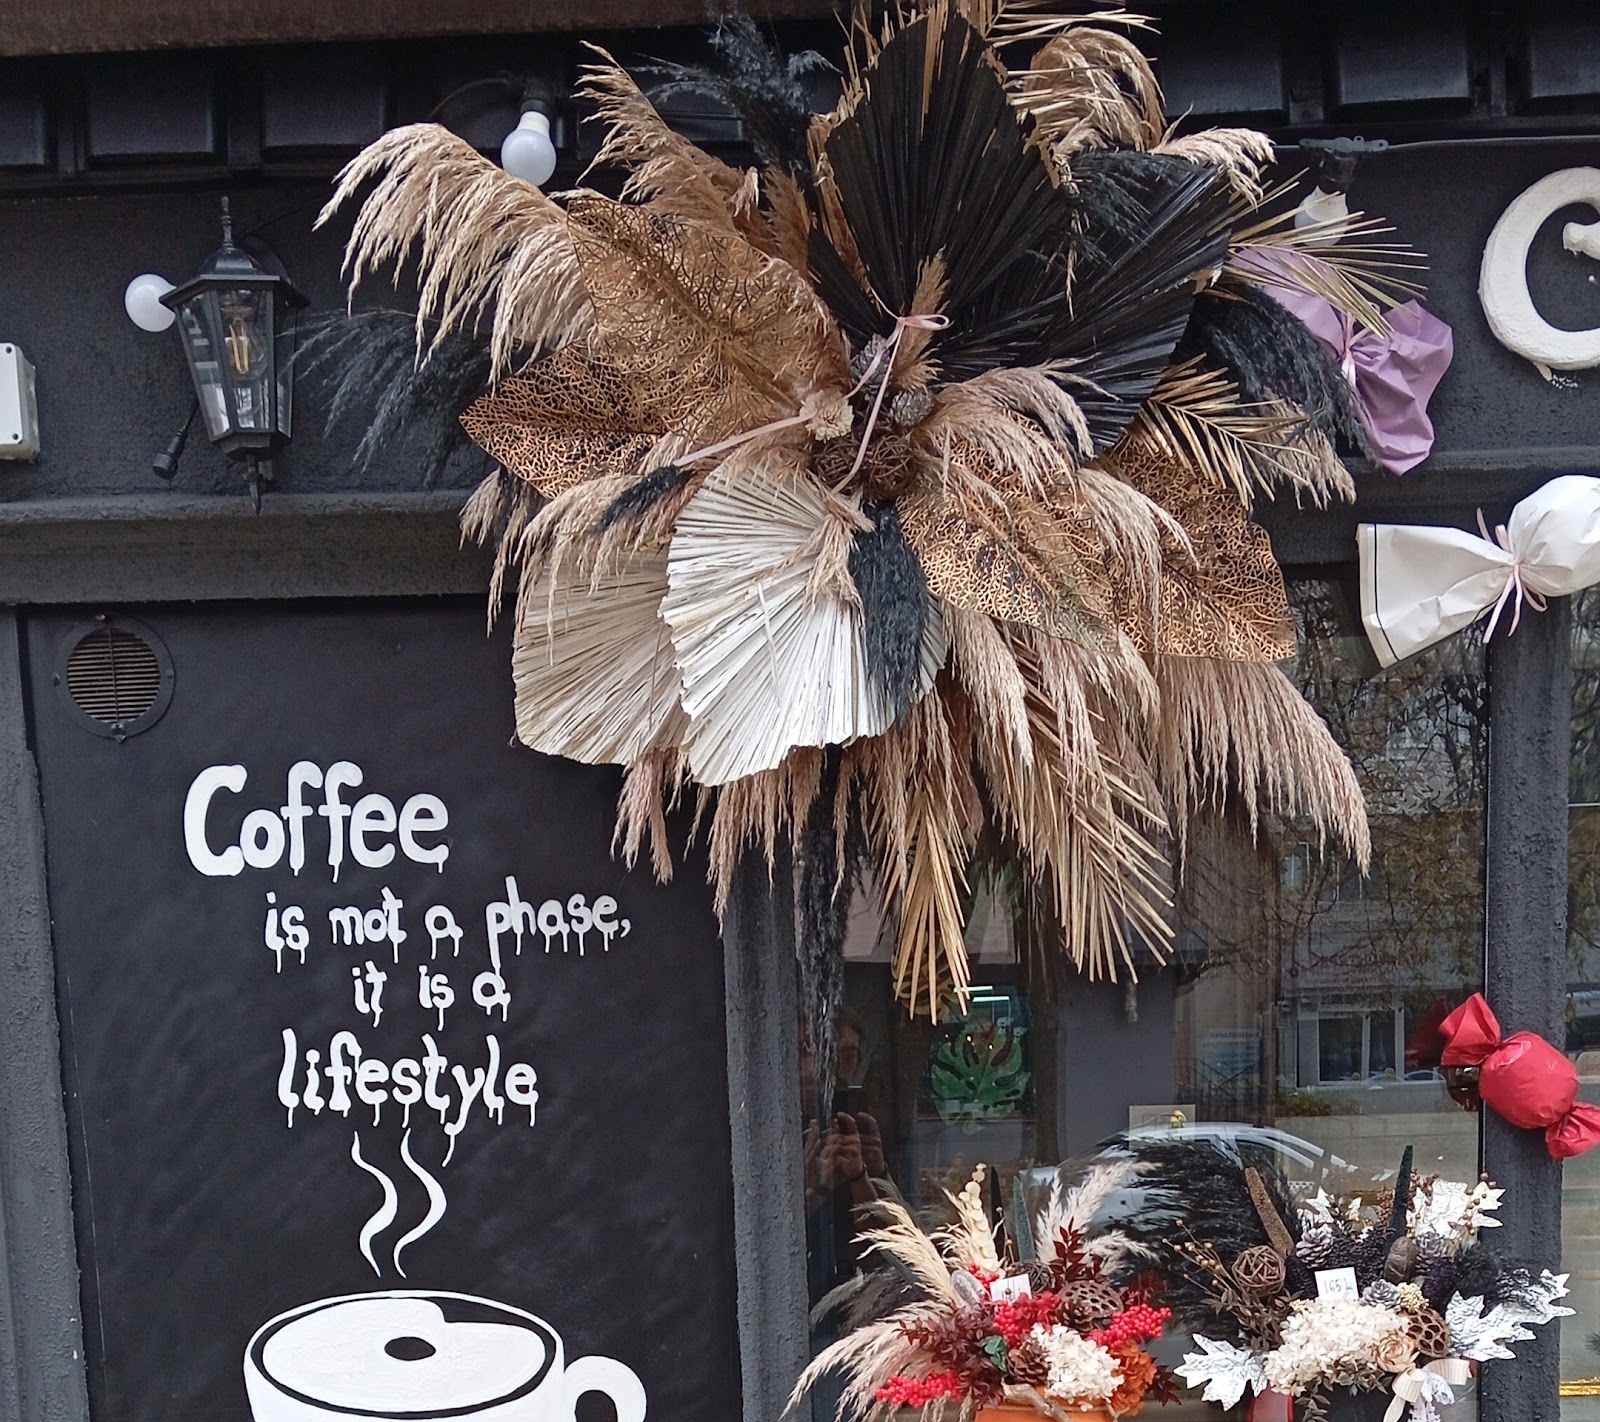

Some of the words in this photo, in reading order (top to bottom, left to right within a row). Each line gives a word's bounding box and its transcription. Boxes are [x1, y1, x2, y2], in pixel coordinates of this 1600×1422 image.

[184, 761, 449, 882] Coffee
[265, 892, 309, 973] is
[329, 887, 407, 963] not
[425, 906, 463, 959] a
[486, 876, 631, 967] phase,
[352, 961, 387, 1027] it
[419, 965, 454, 1031] is
[473, 971, 511, 1021] a
[278, 1028, 538, 1142] lifestyle
[1323, 1279, 1342, 1295] 165
